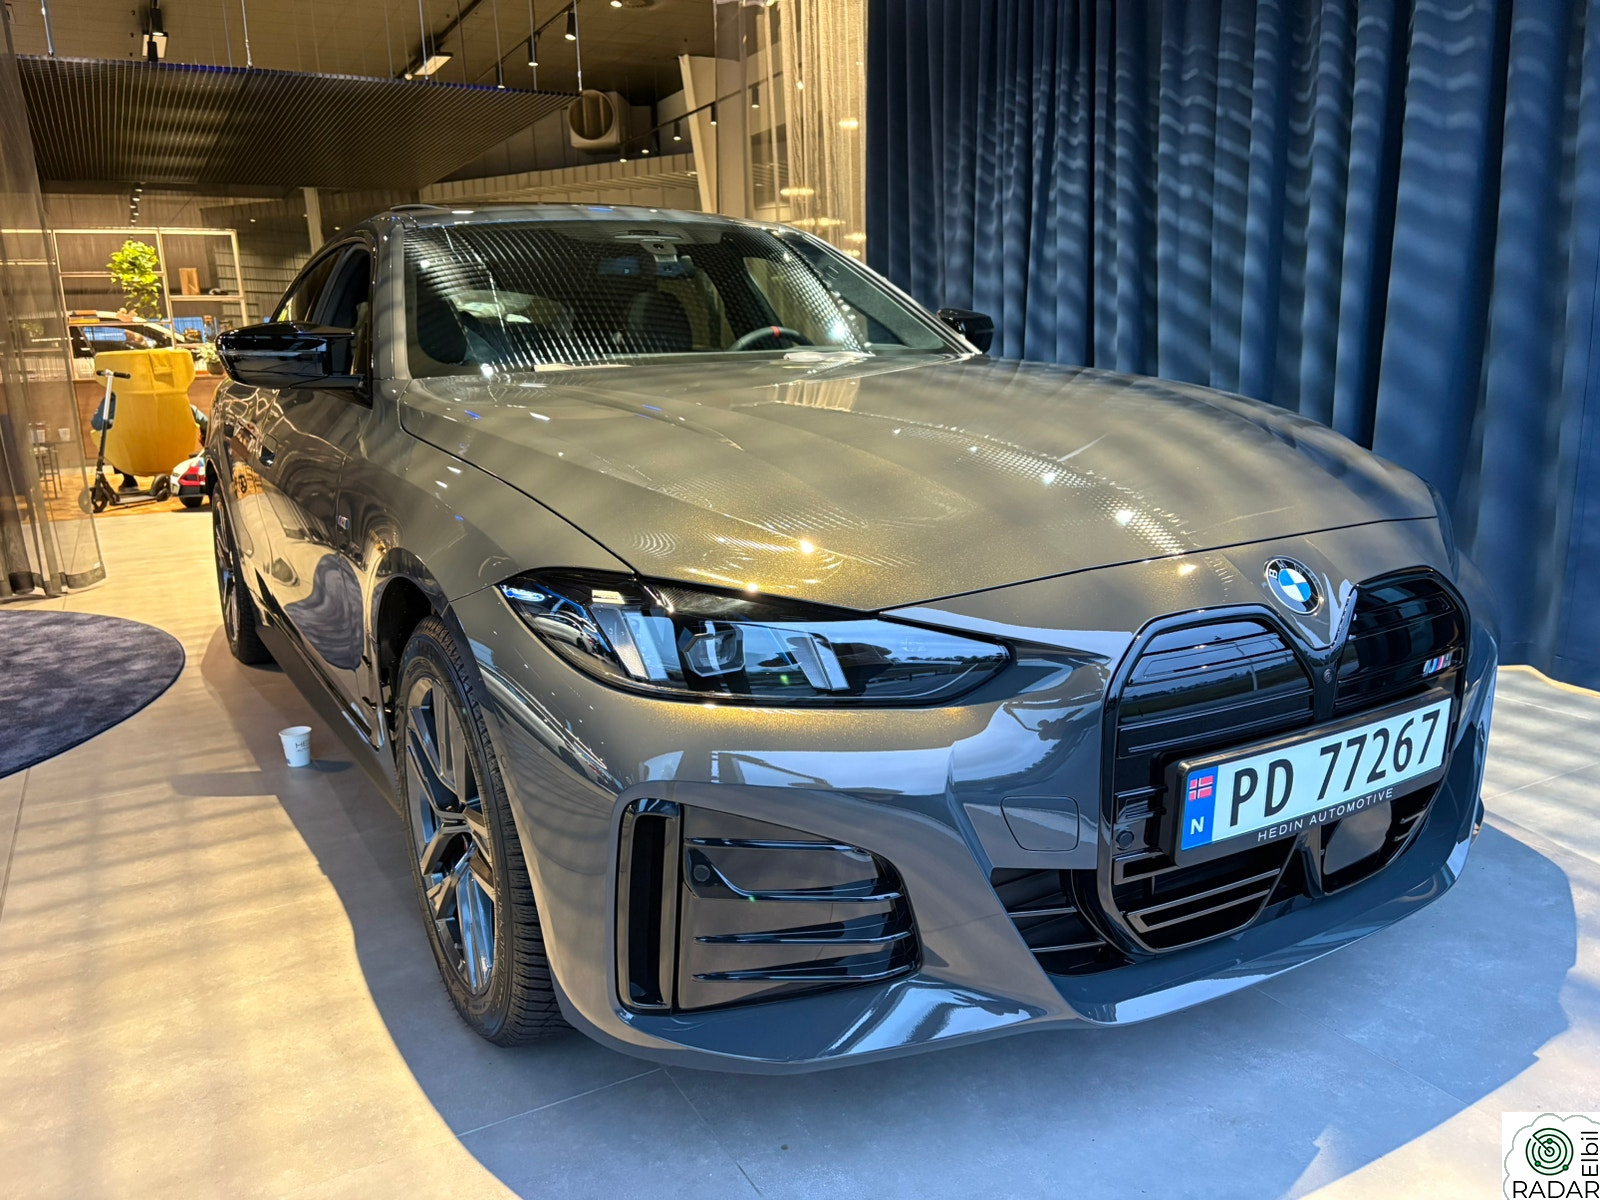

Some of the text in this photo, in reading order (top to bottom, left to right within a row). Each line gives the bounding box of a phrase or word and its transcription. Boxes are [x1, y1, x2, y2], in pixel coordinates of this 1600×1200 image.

[1230, 708, 1441, 828] PD 77267
[1190, 816, 1205, 835] N
[1257, 788, 1394, 842] HEDIN AUTOMOTIVE
